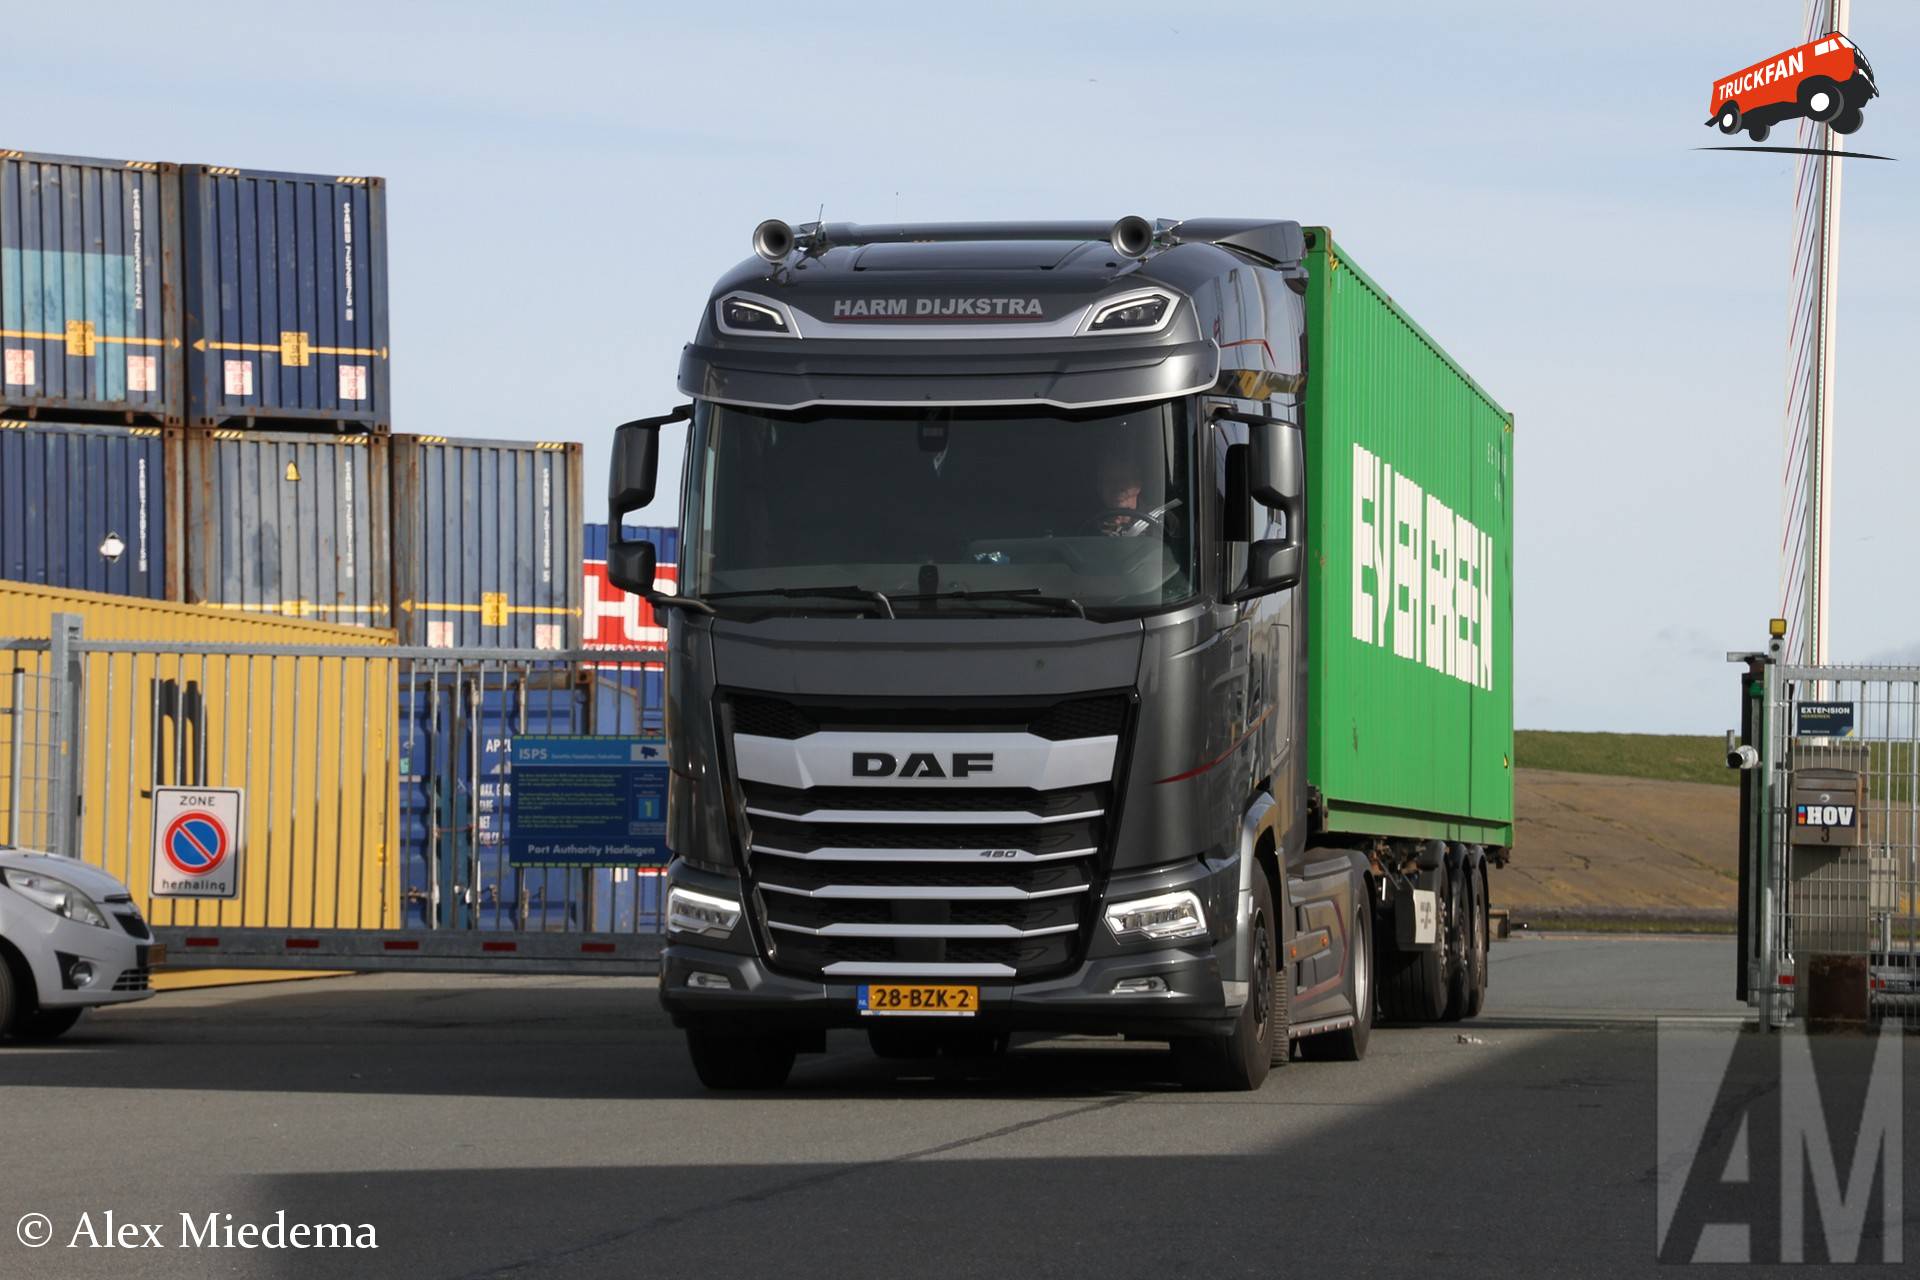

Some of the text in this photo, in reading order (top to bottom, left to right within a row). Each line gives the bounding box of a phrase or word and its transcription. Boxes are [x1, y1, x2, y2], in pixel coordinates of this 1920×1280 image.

[834, 297, 1043, 316] HARM DIJKSTRA
[1352, 442, 1493, 692] EVERGREEN
[1801, 706, 1850, 714] EXTENSION
[519, 748, 547, 760] ISPS
[852, 752, 993, 777] DAF
[180, 796, 215, 807] ZONE
[644, 798, 655, 817] 1
[1806, 806, 1853, 826] HOV
[1821, 828, 1830, 843] 3
[528, 844, 656, 857] Port Authority Harlingen
[161, 880, 226, 892] herhaling
[875, 988, 969, 1008] 28-BZK-2
